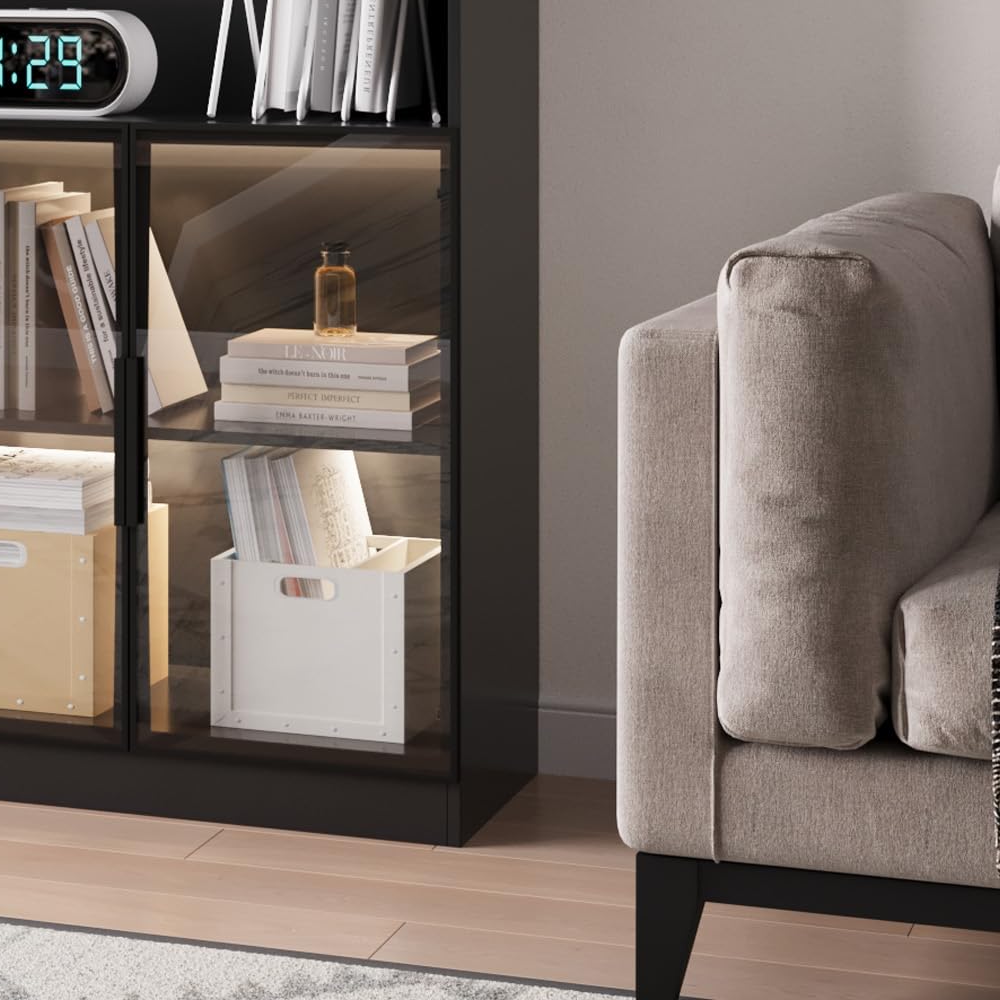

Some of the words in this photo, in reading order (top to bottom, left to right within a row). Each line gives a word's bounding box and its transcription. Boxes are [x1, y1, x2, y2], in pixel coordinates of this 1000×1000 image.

[76, 239, 90, 271] lifestyle
[66, 264, 78, 294] GUIDE
[85, 273, 103, 321] sustainable
[74, 294, 86, 323] GOOD
[82, 323, 89, 331] A
[85, 332, 92, 342] IS
[101, 330, 109, 342] for
[88, 342, 97, 364] THIS
[287, 392, 318, 401] PERFECT
[321, 393, 360, 403] IMPERFECT
